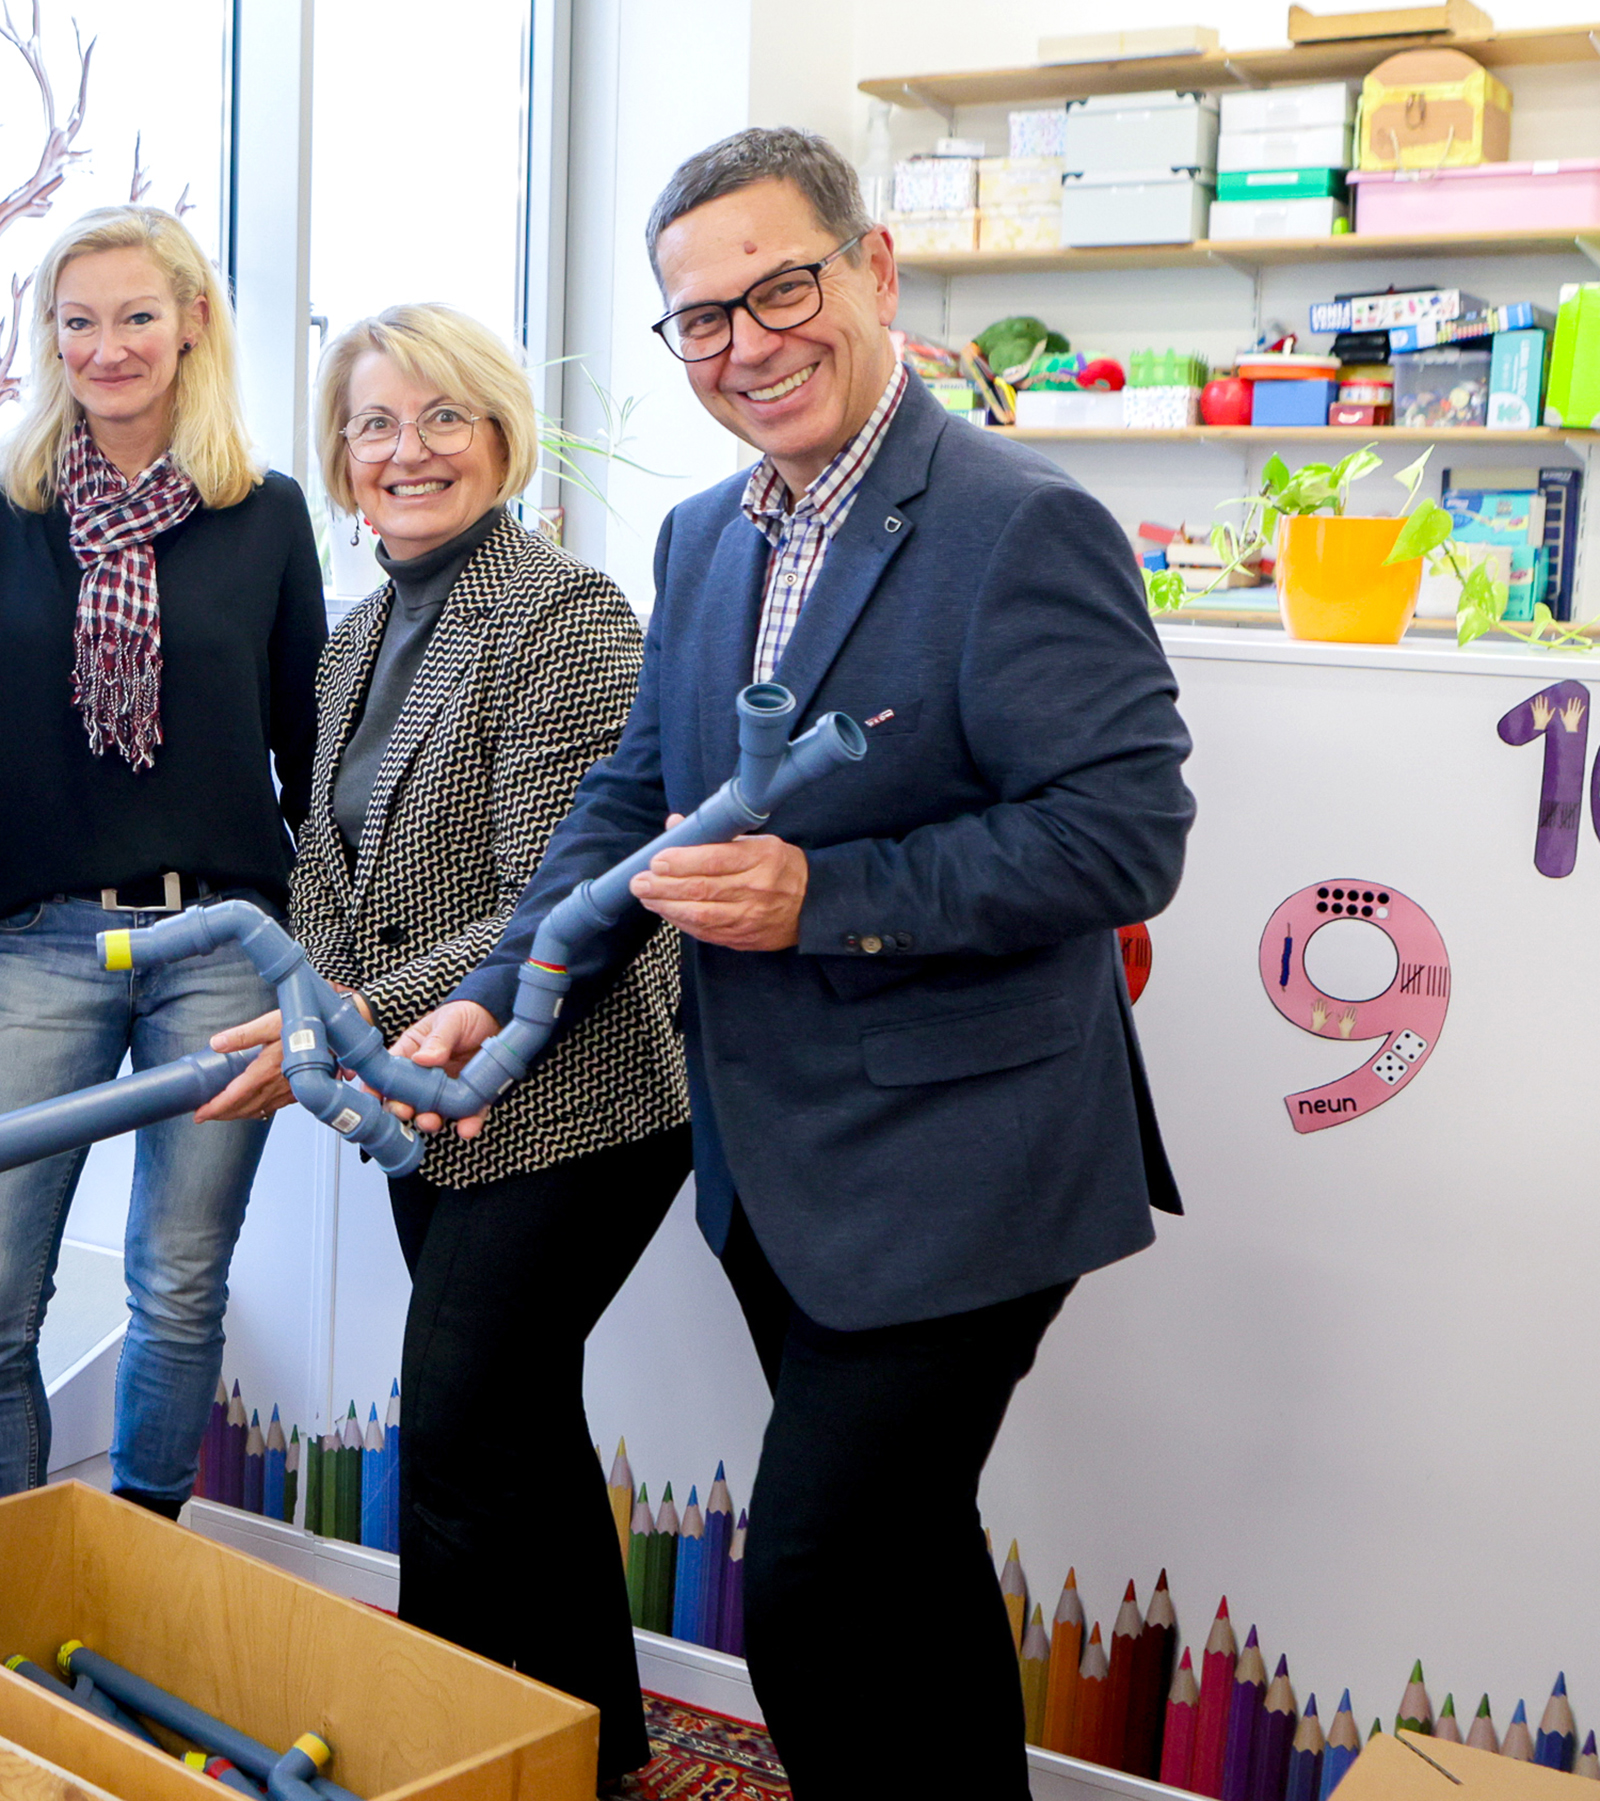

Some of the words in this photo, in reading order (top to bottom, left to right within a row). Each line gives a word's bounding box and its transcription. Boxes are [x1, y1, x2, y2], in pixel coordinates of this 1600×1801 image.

[1497, 679, 1600, 878] 1
[1259, 877, 1452, 1134] 9
[1298, 1095, 1357, 1115] neun
